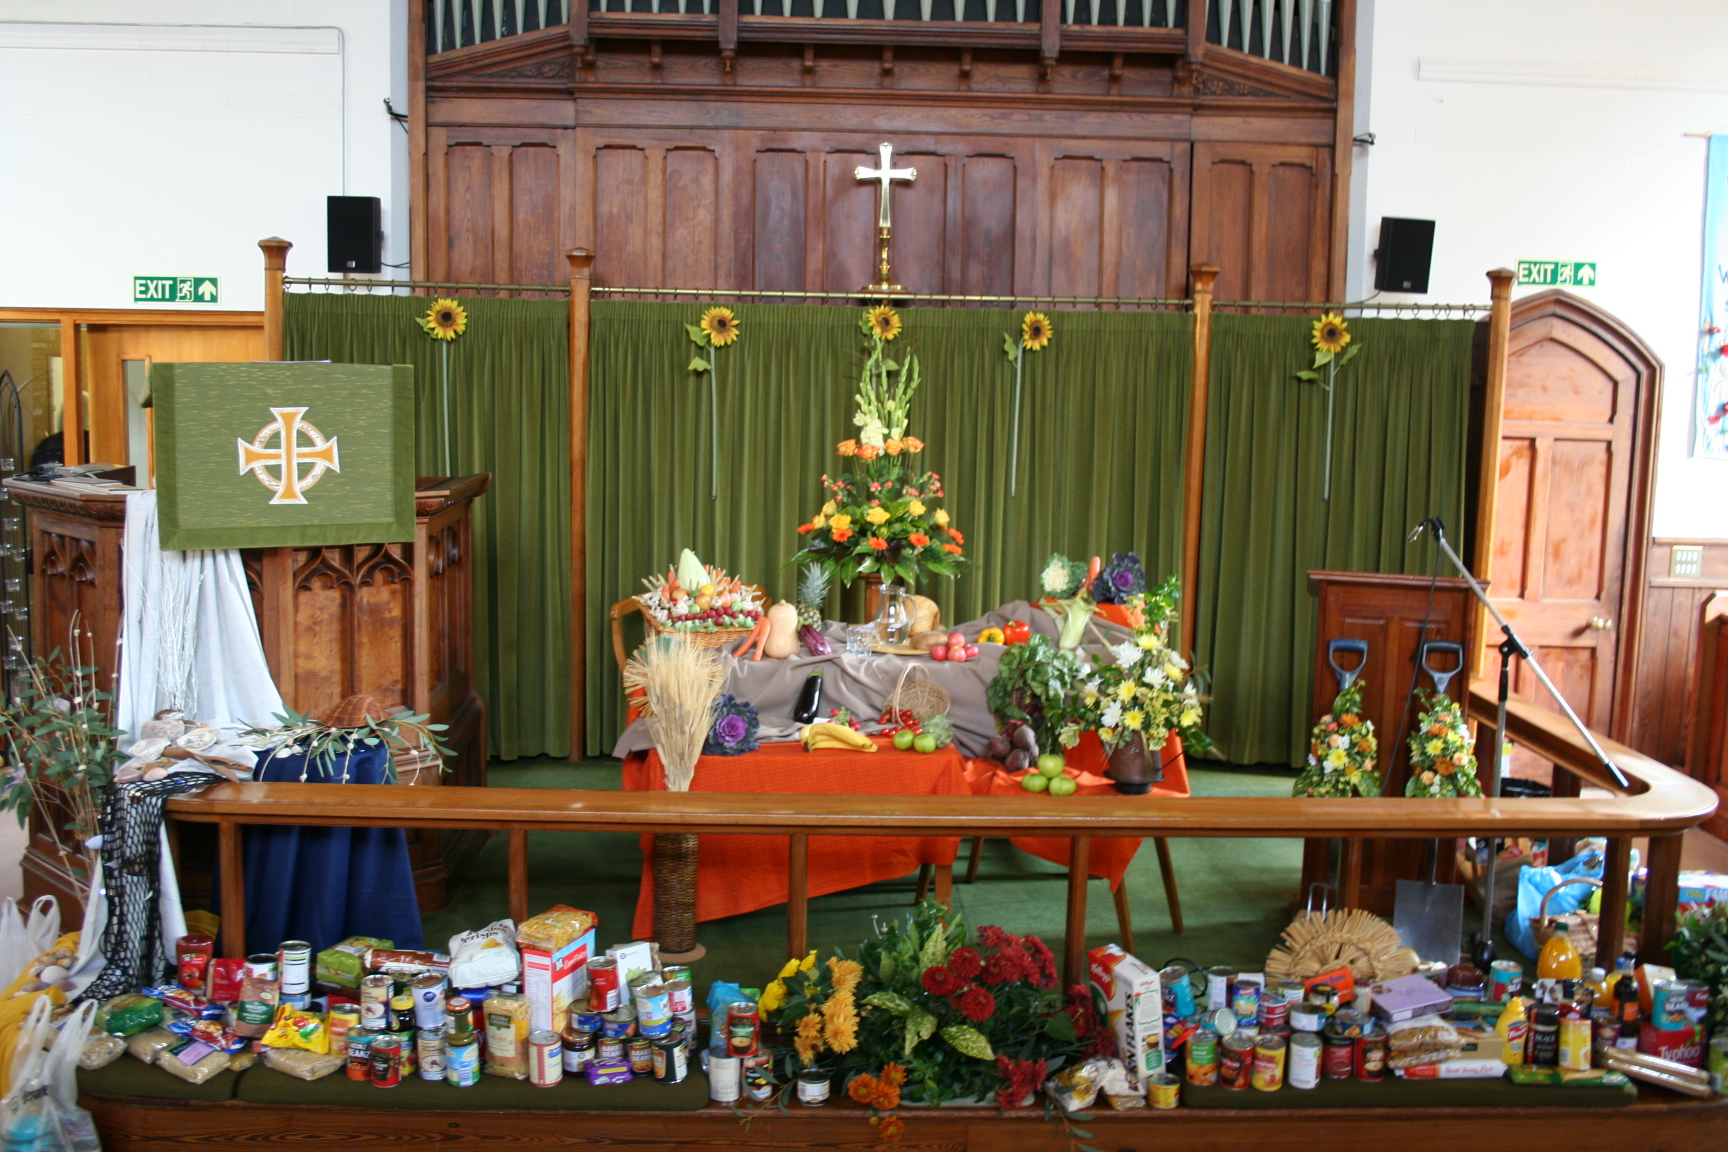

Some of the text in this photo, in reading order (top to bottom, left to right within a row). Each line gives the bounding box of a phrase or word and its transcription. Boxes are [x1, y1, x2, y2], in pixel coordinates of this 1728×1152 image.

[1518, 262, 1555, 283] EXIT
[135, 279, 173, 299] EXIT
[1659, 1045, 1700, 1061] Typhoo
